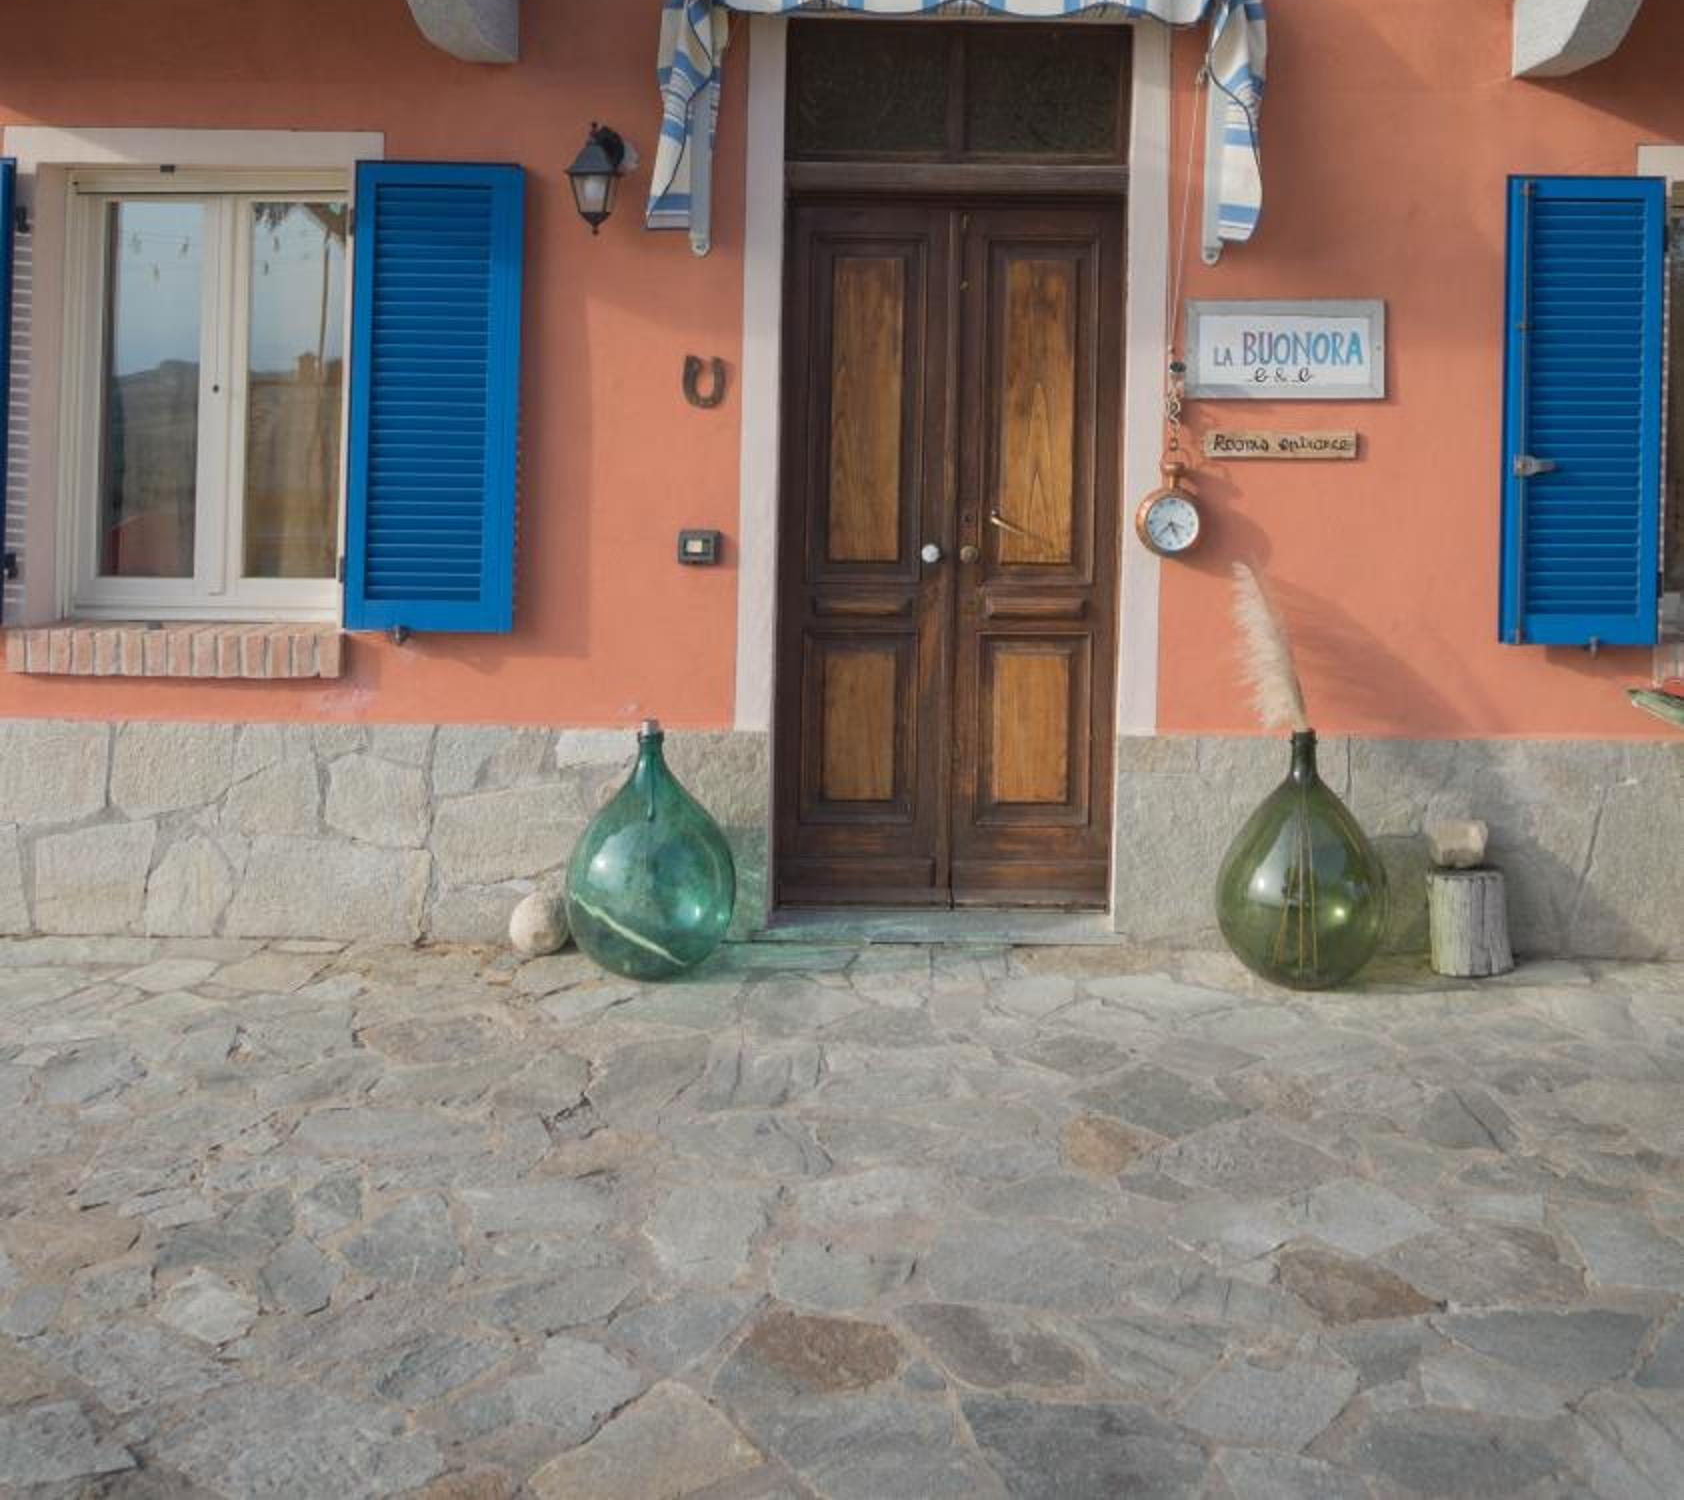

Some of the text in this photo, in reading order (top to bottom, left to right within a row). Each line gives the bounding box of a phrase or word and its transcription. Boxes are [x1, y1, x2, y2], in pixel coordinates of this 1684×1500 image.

[1214, 331, 1363, 366] LA BUONORA
[1213, 434, 1352, 452] Rooms entrance
